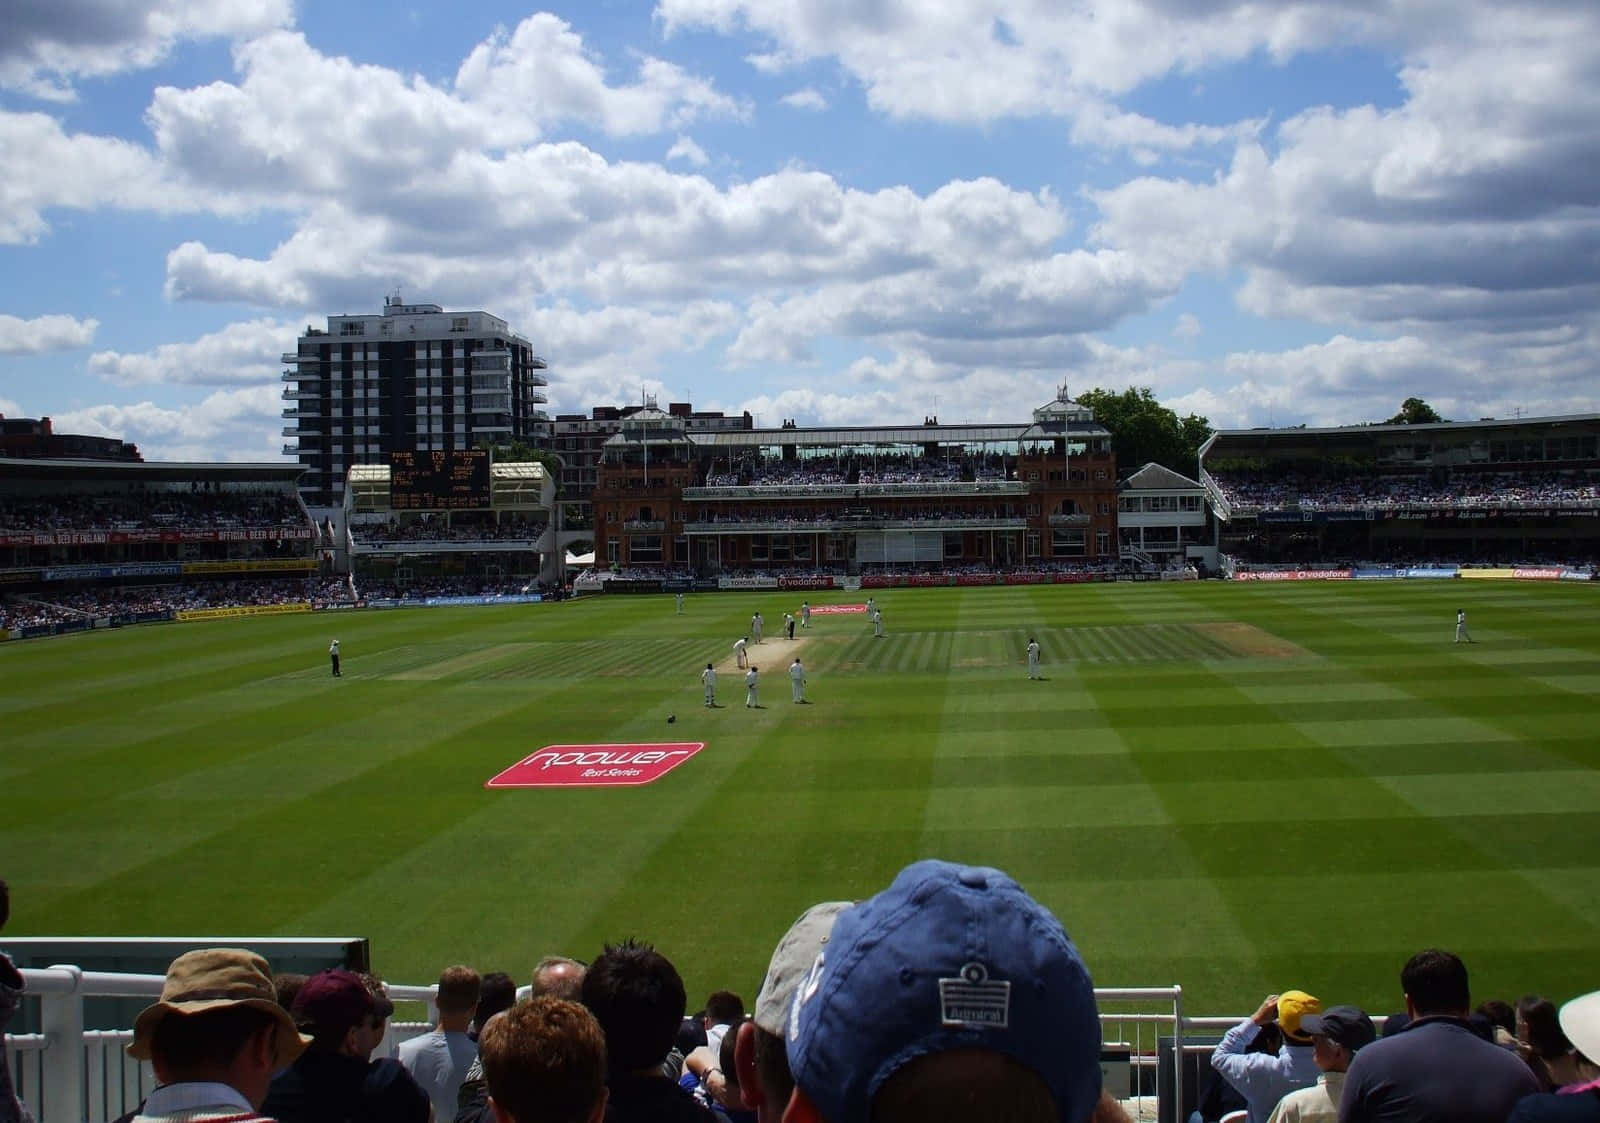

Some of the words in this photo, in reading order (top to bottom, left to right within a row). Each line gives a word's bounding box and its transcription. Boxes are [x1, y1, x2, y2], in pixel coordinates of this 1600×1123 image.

[80, 533, 106, 544] ENGLAND
[218, 530, 248, 541] OFFICIAL
[249, 530, 267, 540] BEER
[269, 530, 278, 539] OF
[279, 528, 311, 539] ENGLAND
[1307, 570, 1350, 578] vodafone
[787, 577, 829, 586] vodafone
[523, 750, 689, 771] npower
[581, 768, 607, 778] Test
[607, 767, 642, 778] Series
